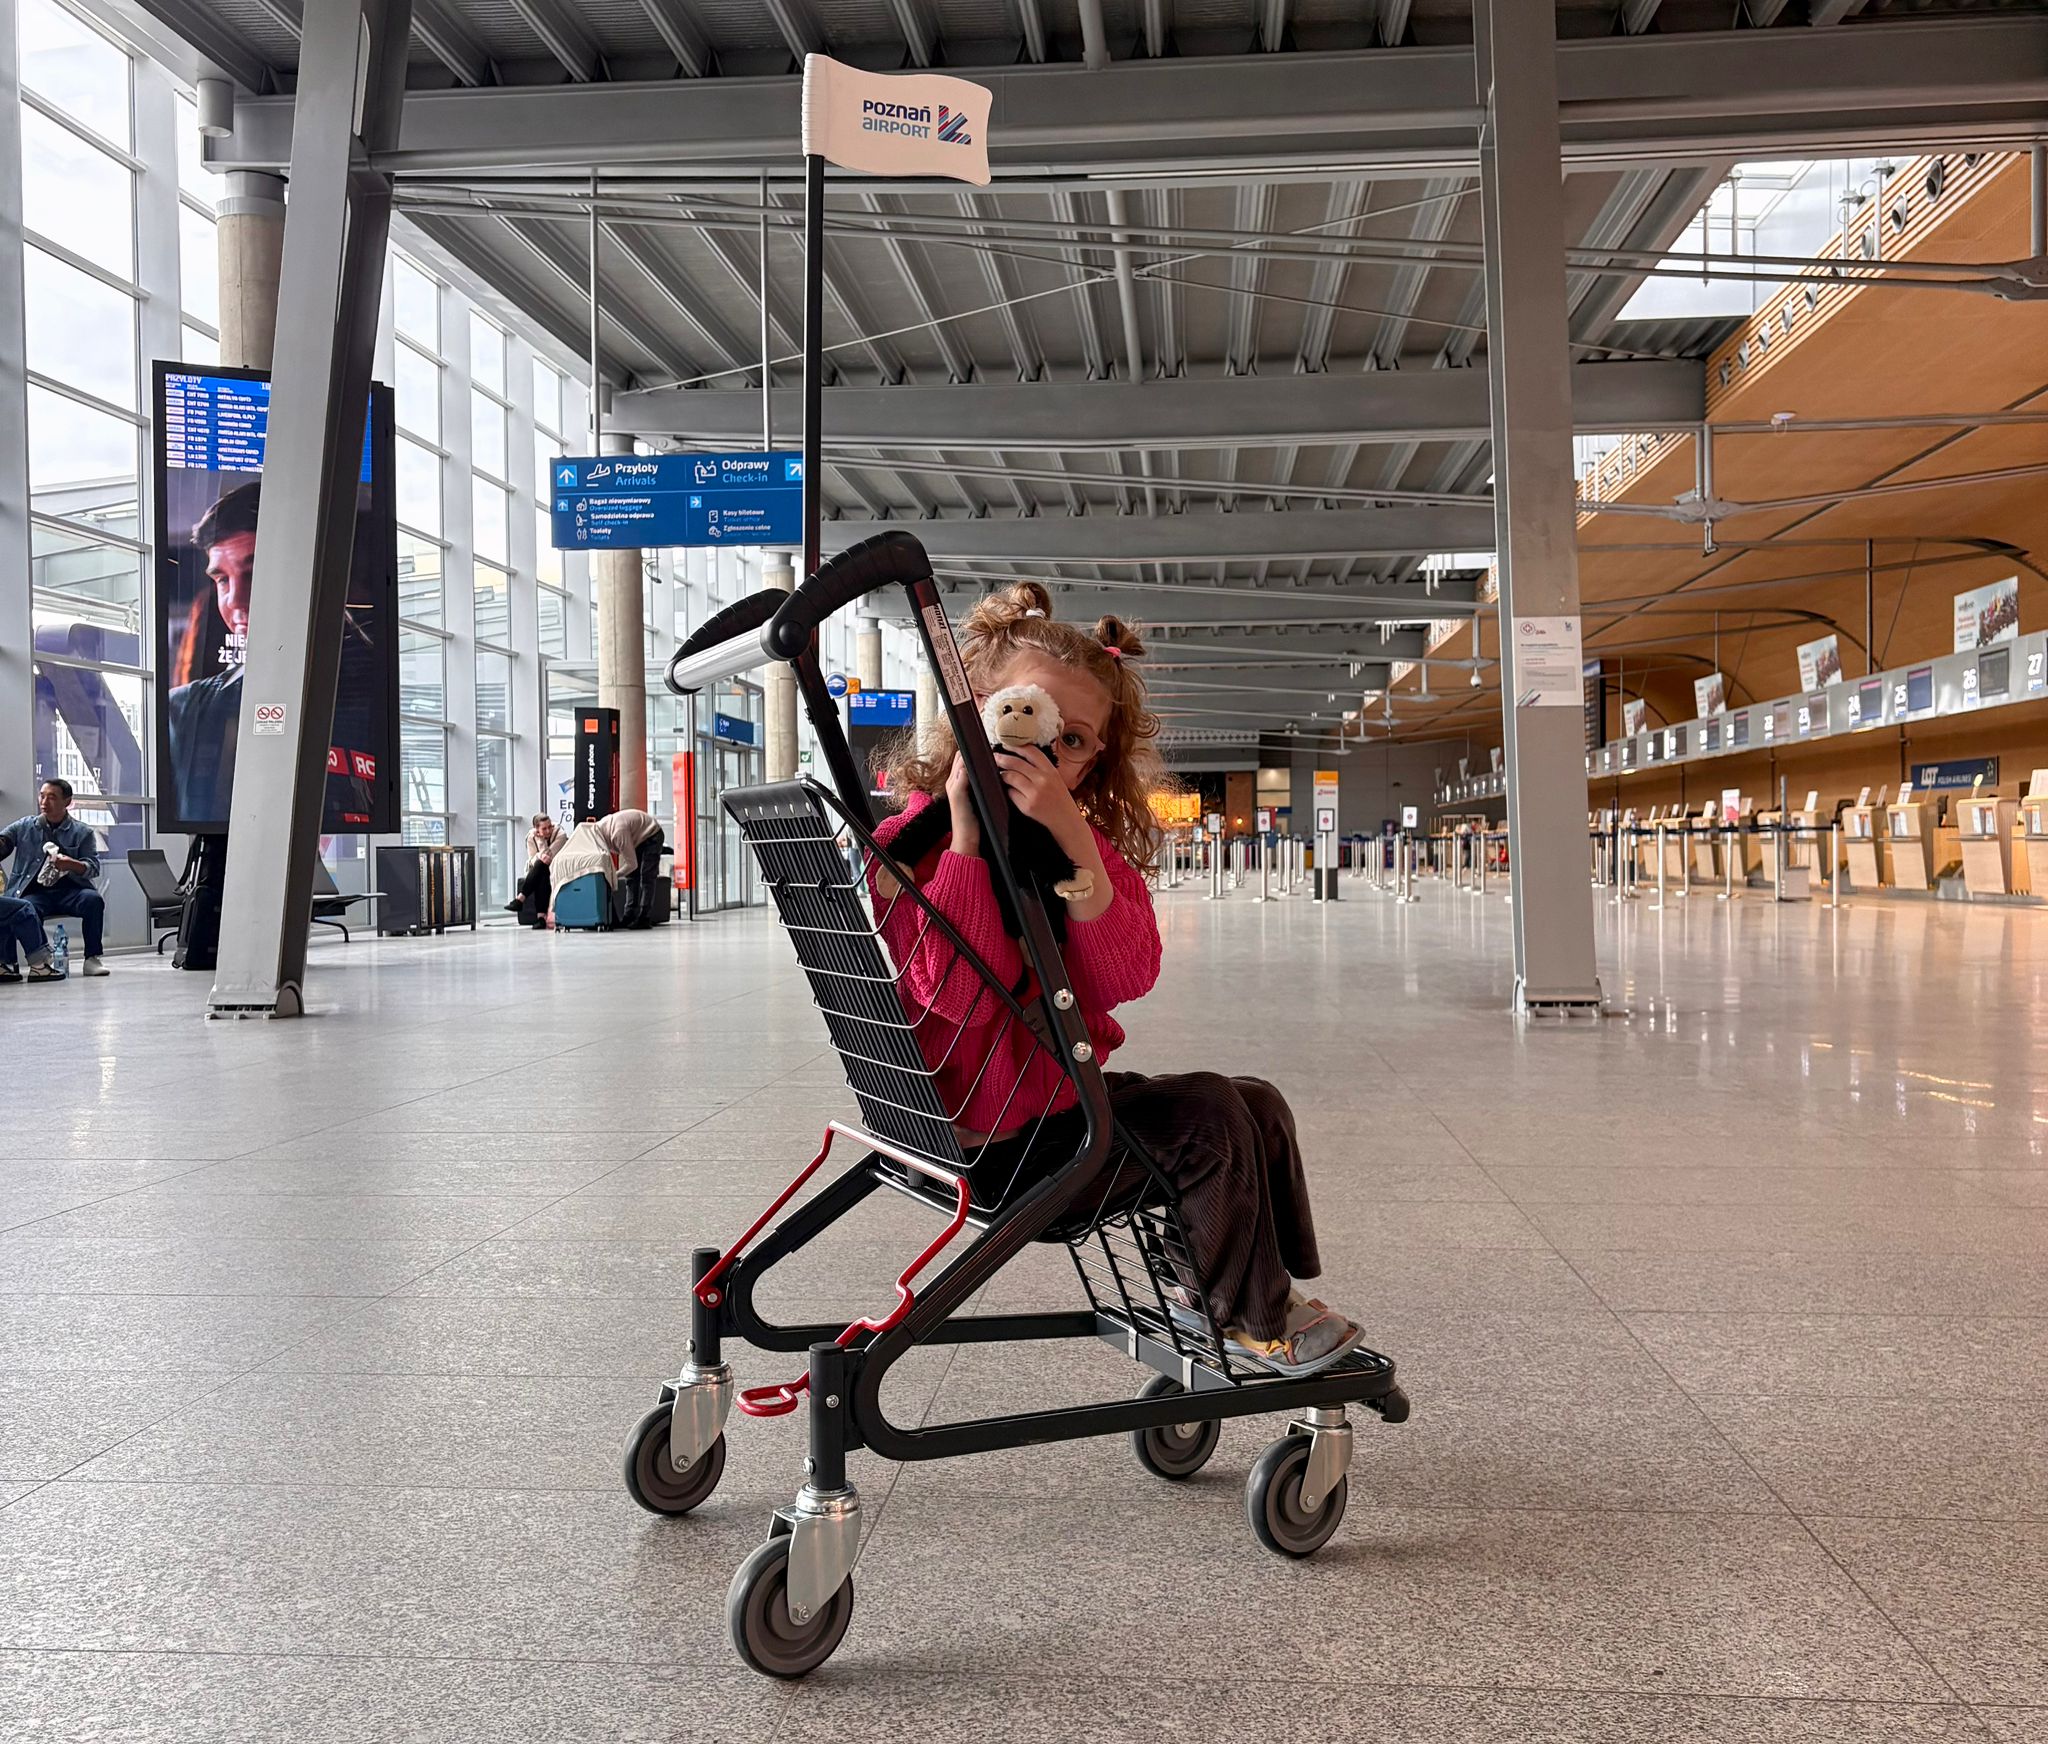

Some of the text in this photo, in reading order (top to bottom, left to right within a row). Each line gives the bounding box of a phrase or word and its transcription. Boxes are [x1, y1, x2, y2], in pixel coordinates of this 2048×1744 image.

[615, 462, 658, 474] Przyloty
[722, 460, 770, 472] Odprawy
[616, 476, 656, 486] Arrivals
[722, 473, 768, 482] Check-in
[218, 646, 233, 663] ŻE
[2028, 653, 2043, 676] 27
[1963, 669, 1976, 690] 26
[1895, 685, 1906, 704] 25
[588, 744, 596, 766] phone
[1921, 766, 1939, 786] LOT
[588, 784, 596, 809] Charge
